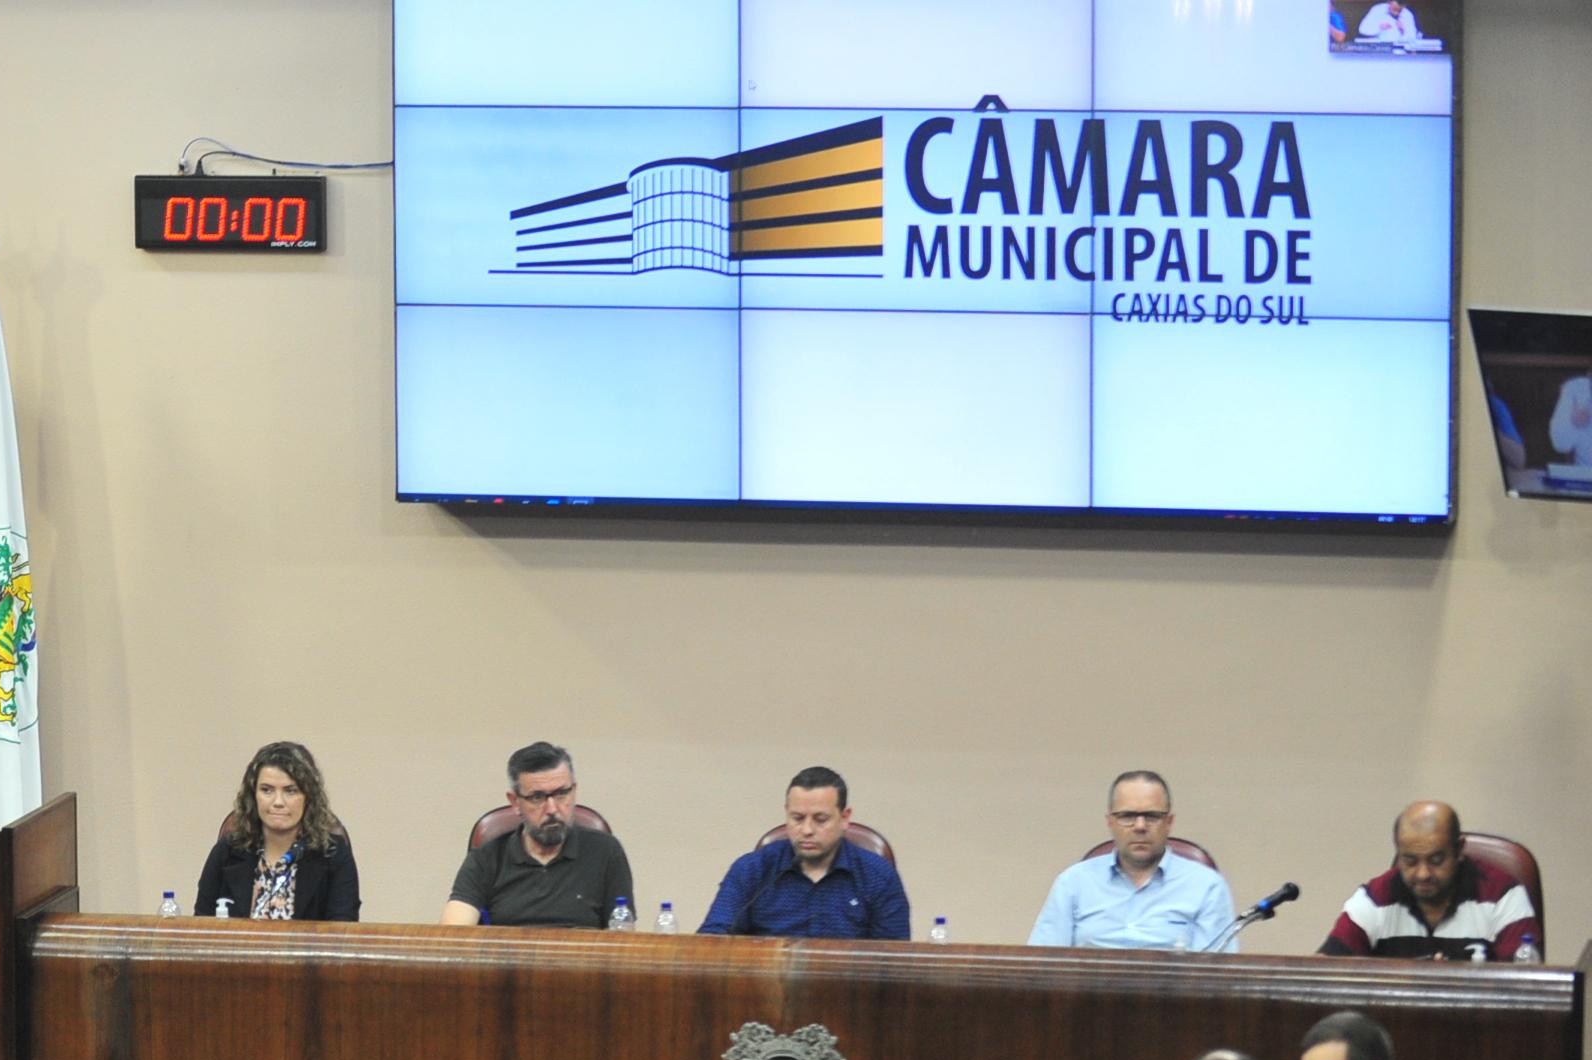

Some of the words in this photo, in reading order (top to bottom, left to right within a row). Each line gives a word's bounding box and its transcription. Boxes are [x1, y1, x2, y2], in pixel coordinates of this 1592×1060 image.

[904, 94, 1312, 219] CÂMARA
[164, 197, 306, 242] 00:00
[904, 224, 1223, 283] MUNICIPAL
[1244, 229, 1312, 285] DE
[1111, 292, 1206, 324] CAXIAS
[1214, 294, 1253, 324] DO
[1261, 295, 1310, 326] SUL
